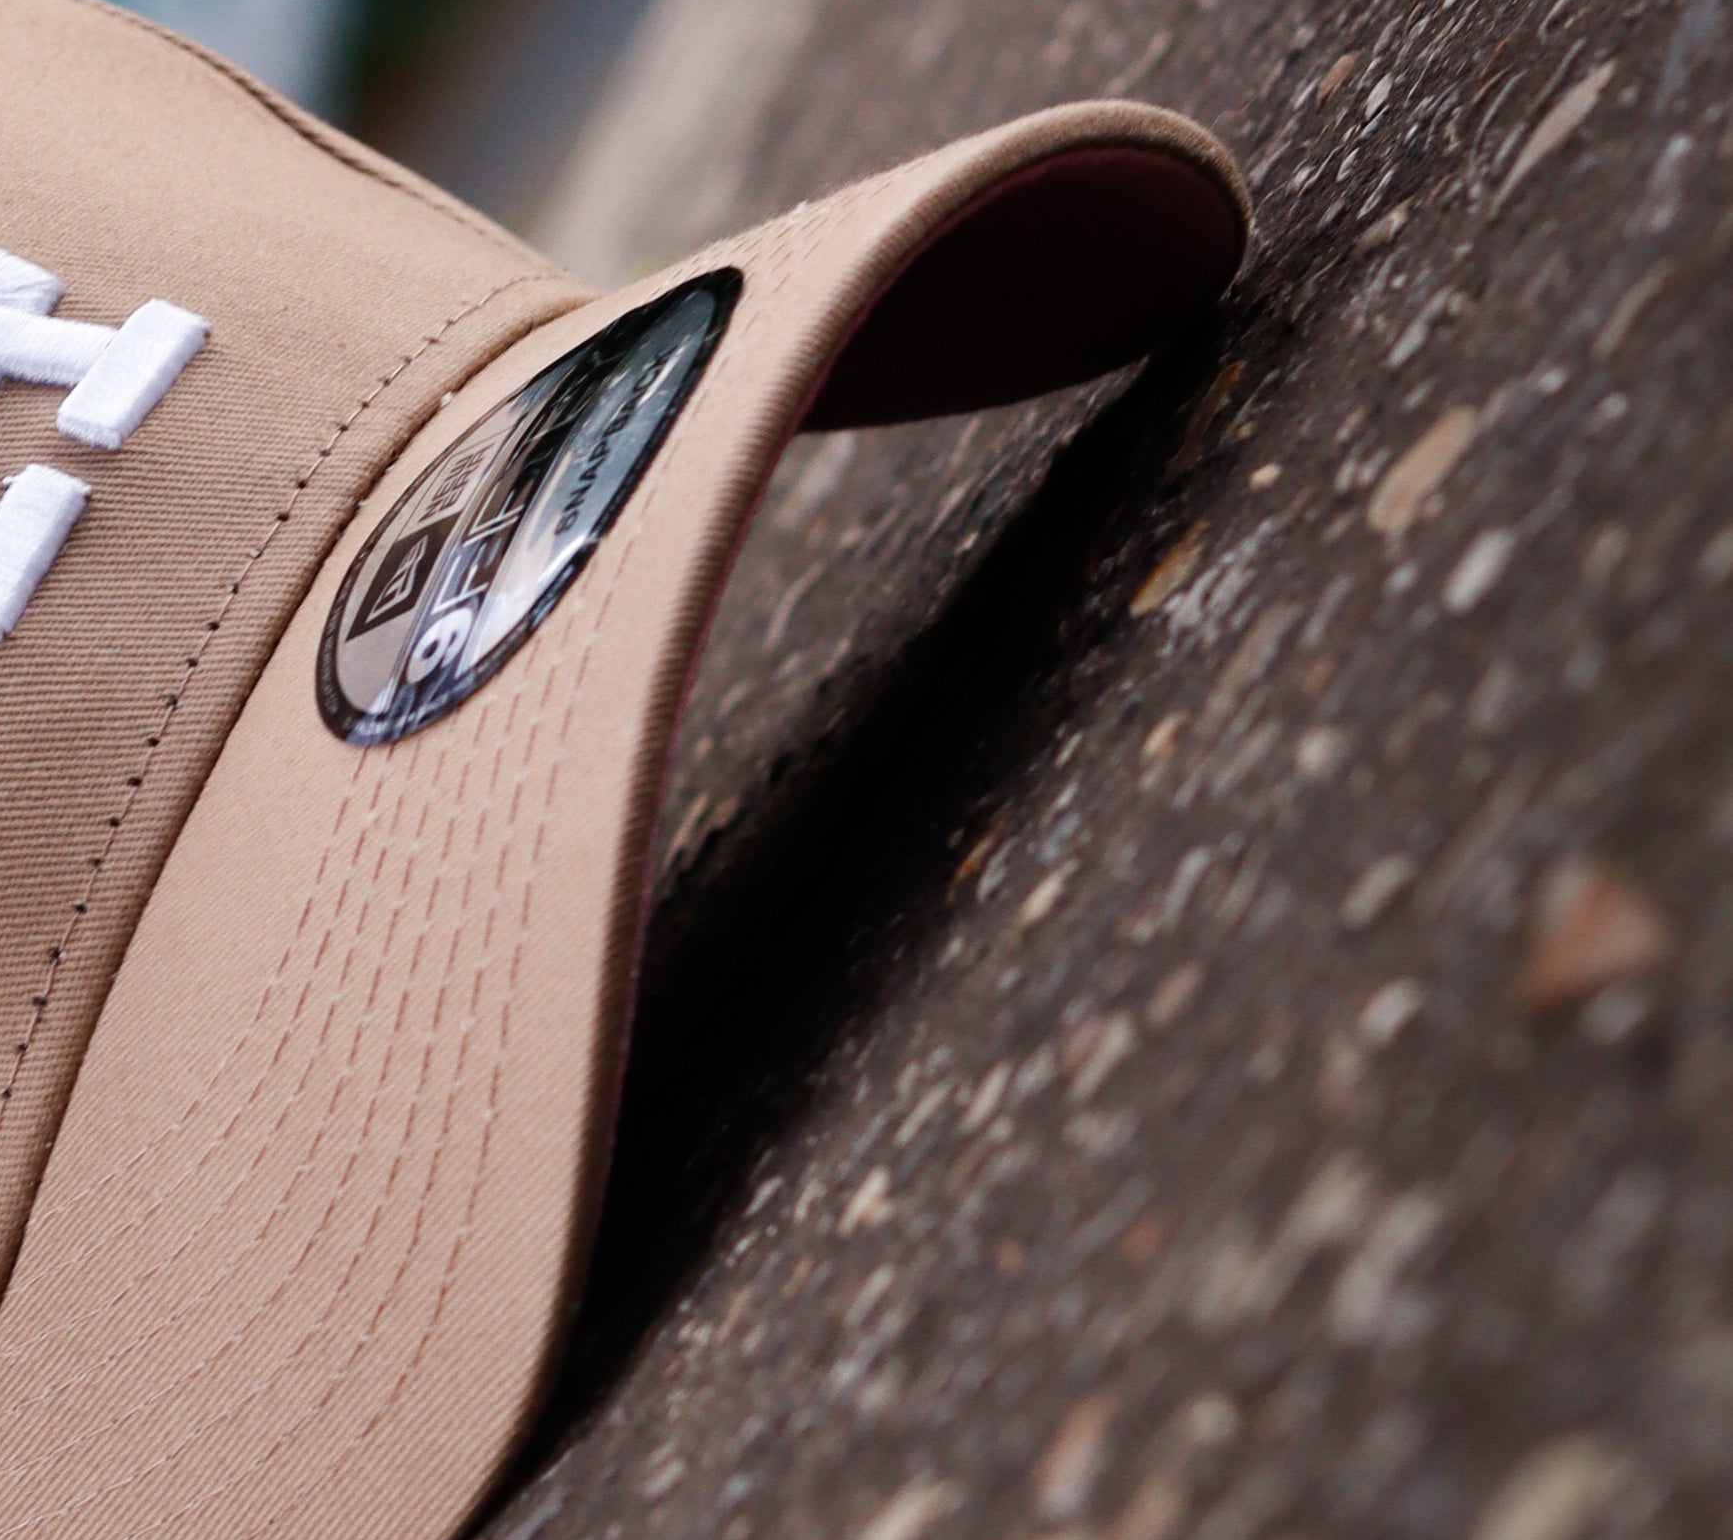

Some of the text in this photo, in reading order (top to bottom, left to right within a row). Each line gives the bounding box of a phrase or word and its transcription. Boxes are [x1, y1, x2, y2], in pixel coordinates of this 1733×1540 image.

[555, 344, 680, 535] SNAPBACK
[418, 453, 474, 523] NEW
[439, 442, 495, 512] ERA
